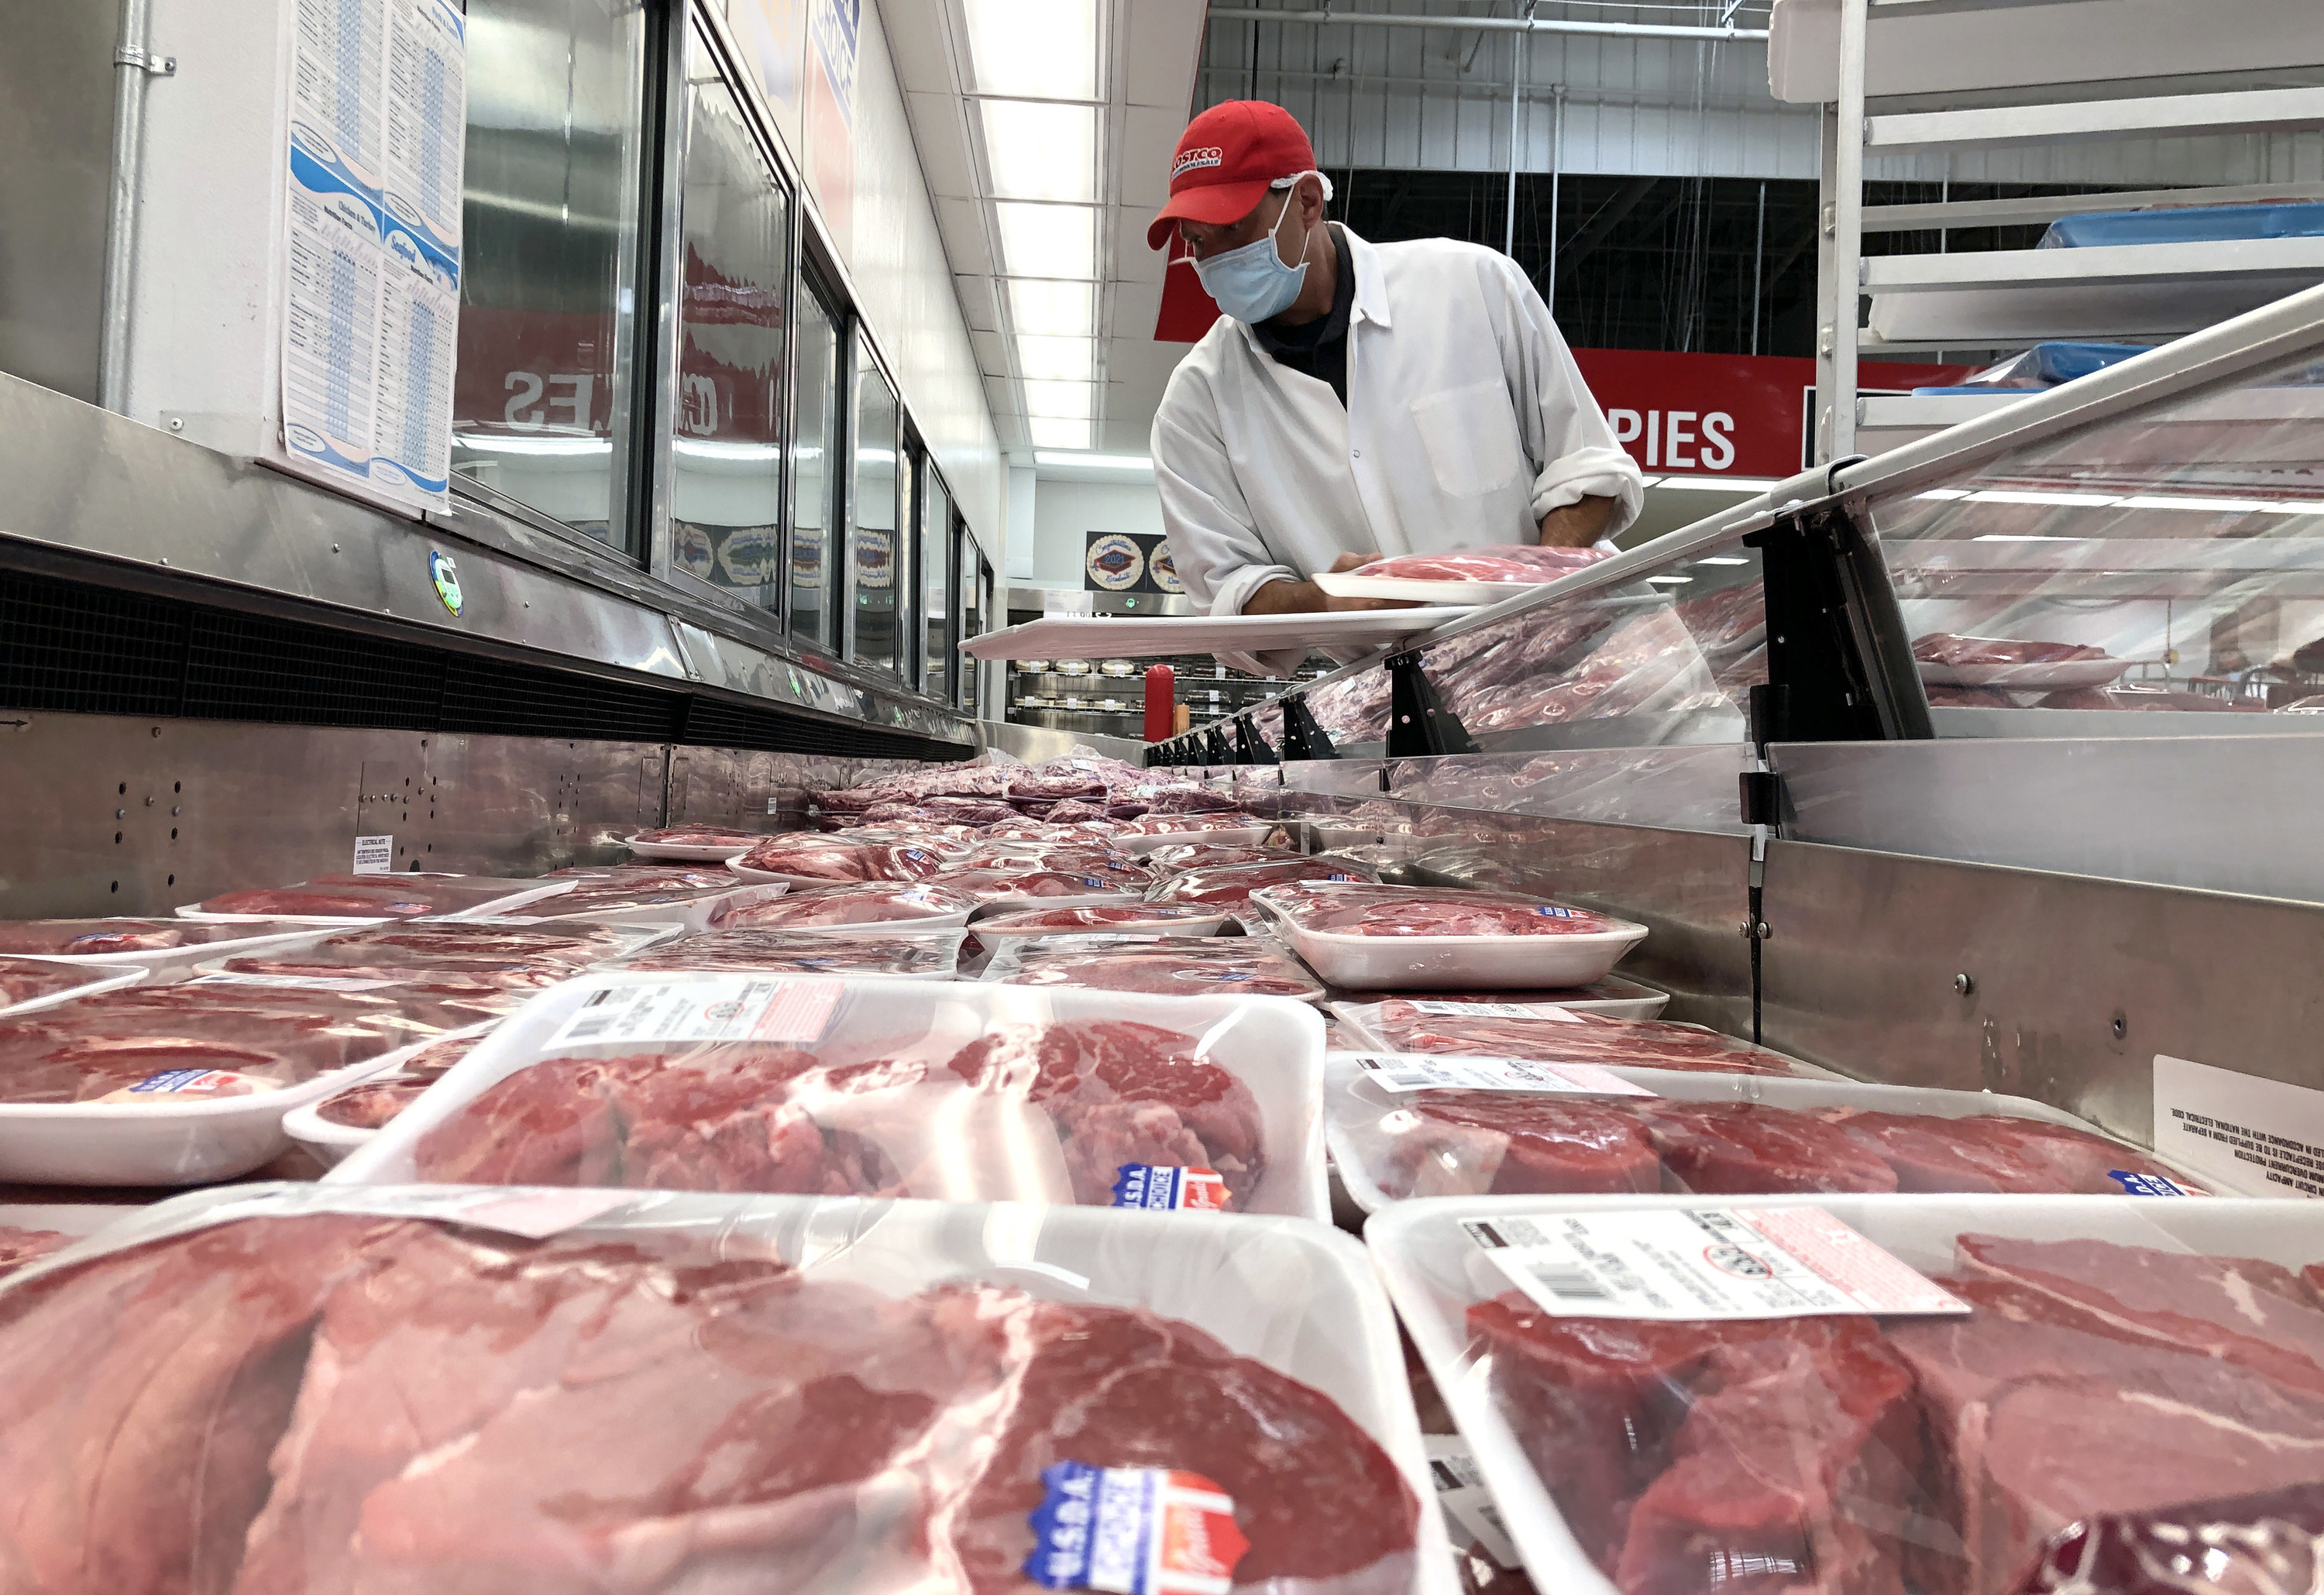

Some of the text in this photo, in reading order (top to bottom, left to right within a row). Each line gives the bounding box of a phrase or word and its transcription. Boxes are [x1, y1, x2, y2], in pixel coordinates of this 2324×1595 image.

[391, 234, 417, 263] Seafood
[1105, 554, 1124, 564] 2021
[2185, 1112, 2213, 1127] ELECTRICAL
[2183, 1122, 2207, 1136] SEPARATE
[2208, 1129, 2212, 1138] A
[2214, 1119, 2240, 1135] NATIONAL
[2241, 1126, 2251, 1138] THE
[2213, 1130, 2228, 1143] FROM
[2229, 1135, 2254, 1150] SUPPLIED
[2253, 1129, 2267, 1143] WITH
[2267, 1134, 2304, 1152] ACCORDANCE
[2255, 1143, 2263, 1153] BE
[2264, 1145, 2271, 1156] TO
[2272, 1147, 2278, 1157] IS
[2305, 1144, 2312, 1155] IN
[2234, 1149, 2267, 1167] PROTECTION
[2279, 1150, 2314, 1167] RECEPTACLE
[2267, 1159, 2308, 1179] OVERCURRENT
[2266, 1170, 2294, 1188] AMPACITY
[2295, 1180, 2317, 1195] CIRCUIT
